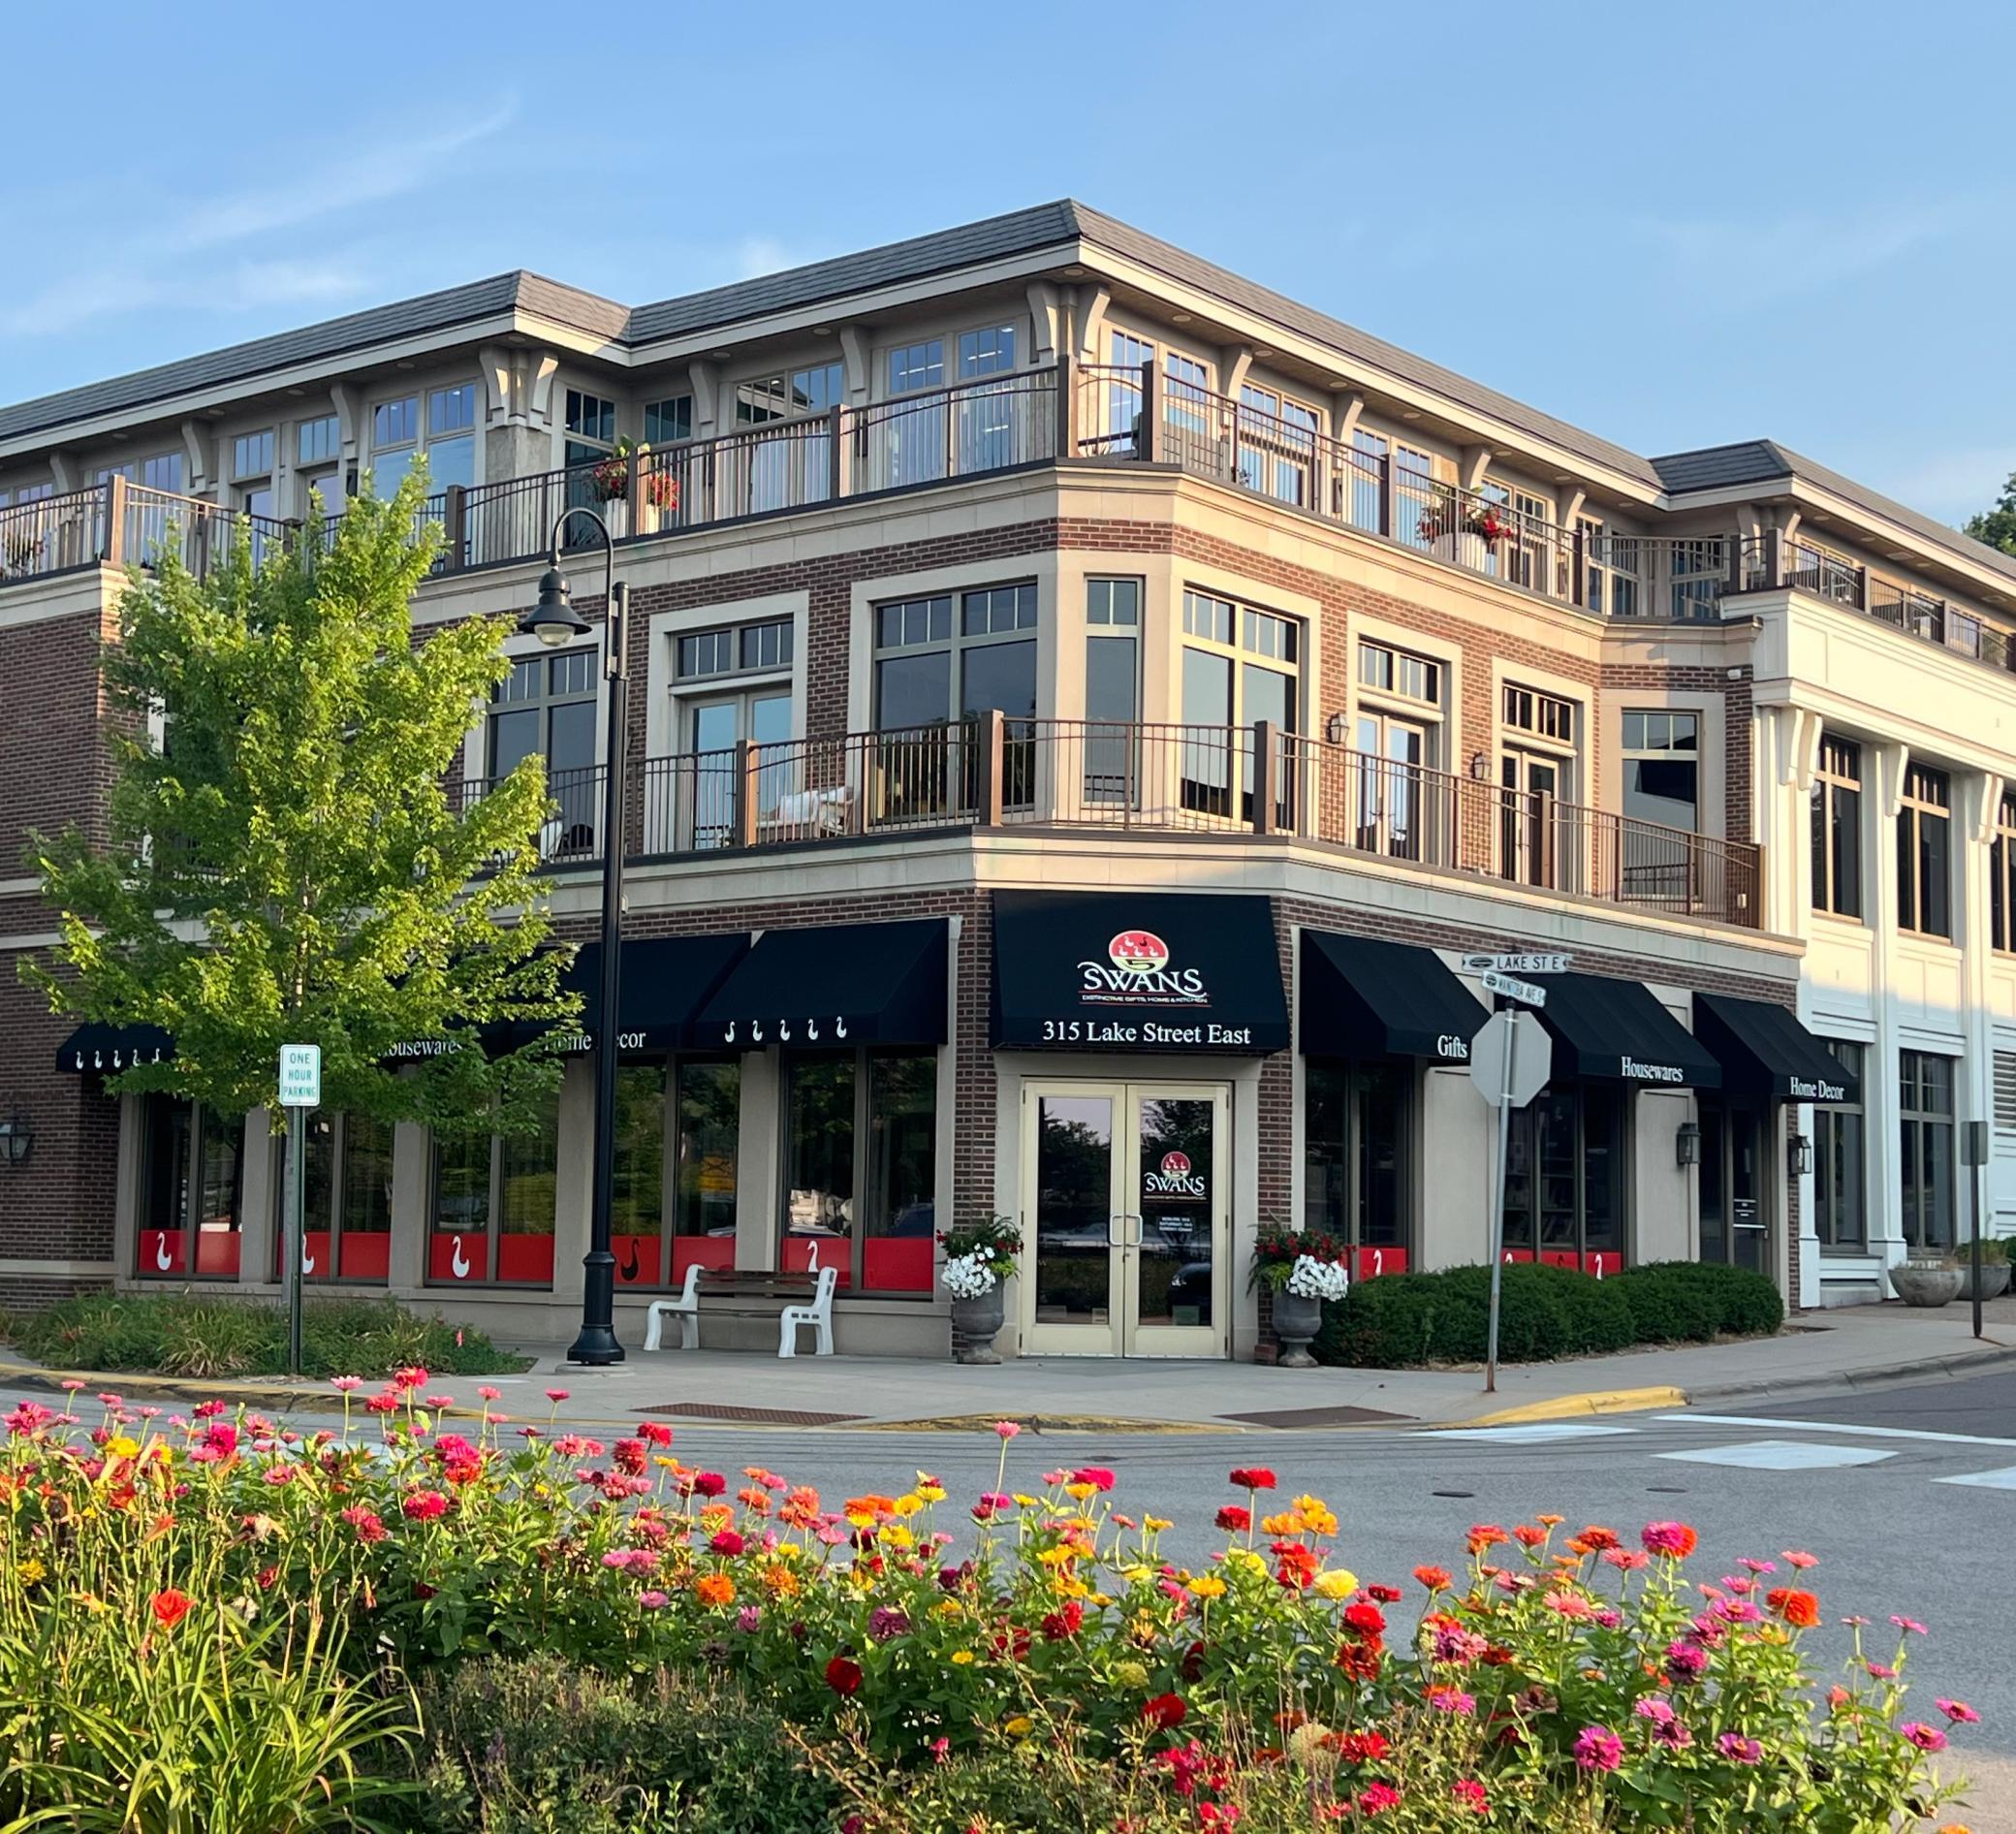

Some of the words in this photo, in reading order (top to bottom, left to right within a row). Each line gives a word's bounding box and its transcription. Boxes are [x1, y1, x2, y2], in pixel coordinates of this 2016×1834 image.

[1497, 957, 1528, 969] LAKE
[1533, 957, 1548, 969] ST
[1553, 957, 1559, 969] E
[1077, 962, 1208, 998] SWANS
[1043, 1021, 1080, 1041] 315
[1087, 1022, 1137, 1042] Lake
[1143, 1023, 1202, 1043] Street
[1208, 1024, 1251, 1045] East
[1437, 1034, 1468, 1058] Gifts
[290, 1053, 310, 1064] ONE
[1621, 1056, 1684, 1083] Housewares
[288, 1069, 312, 1081] HOUR
[283, 1086, 317, 1097] PARKING
[1790, 1076, 1817, 1097] Home
[1817, 1079, 1845, 1101] Decor
[1144, 1172, 1206, 1196] SWANS
